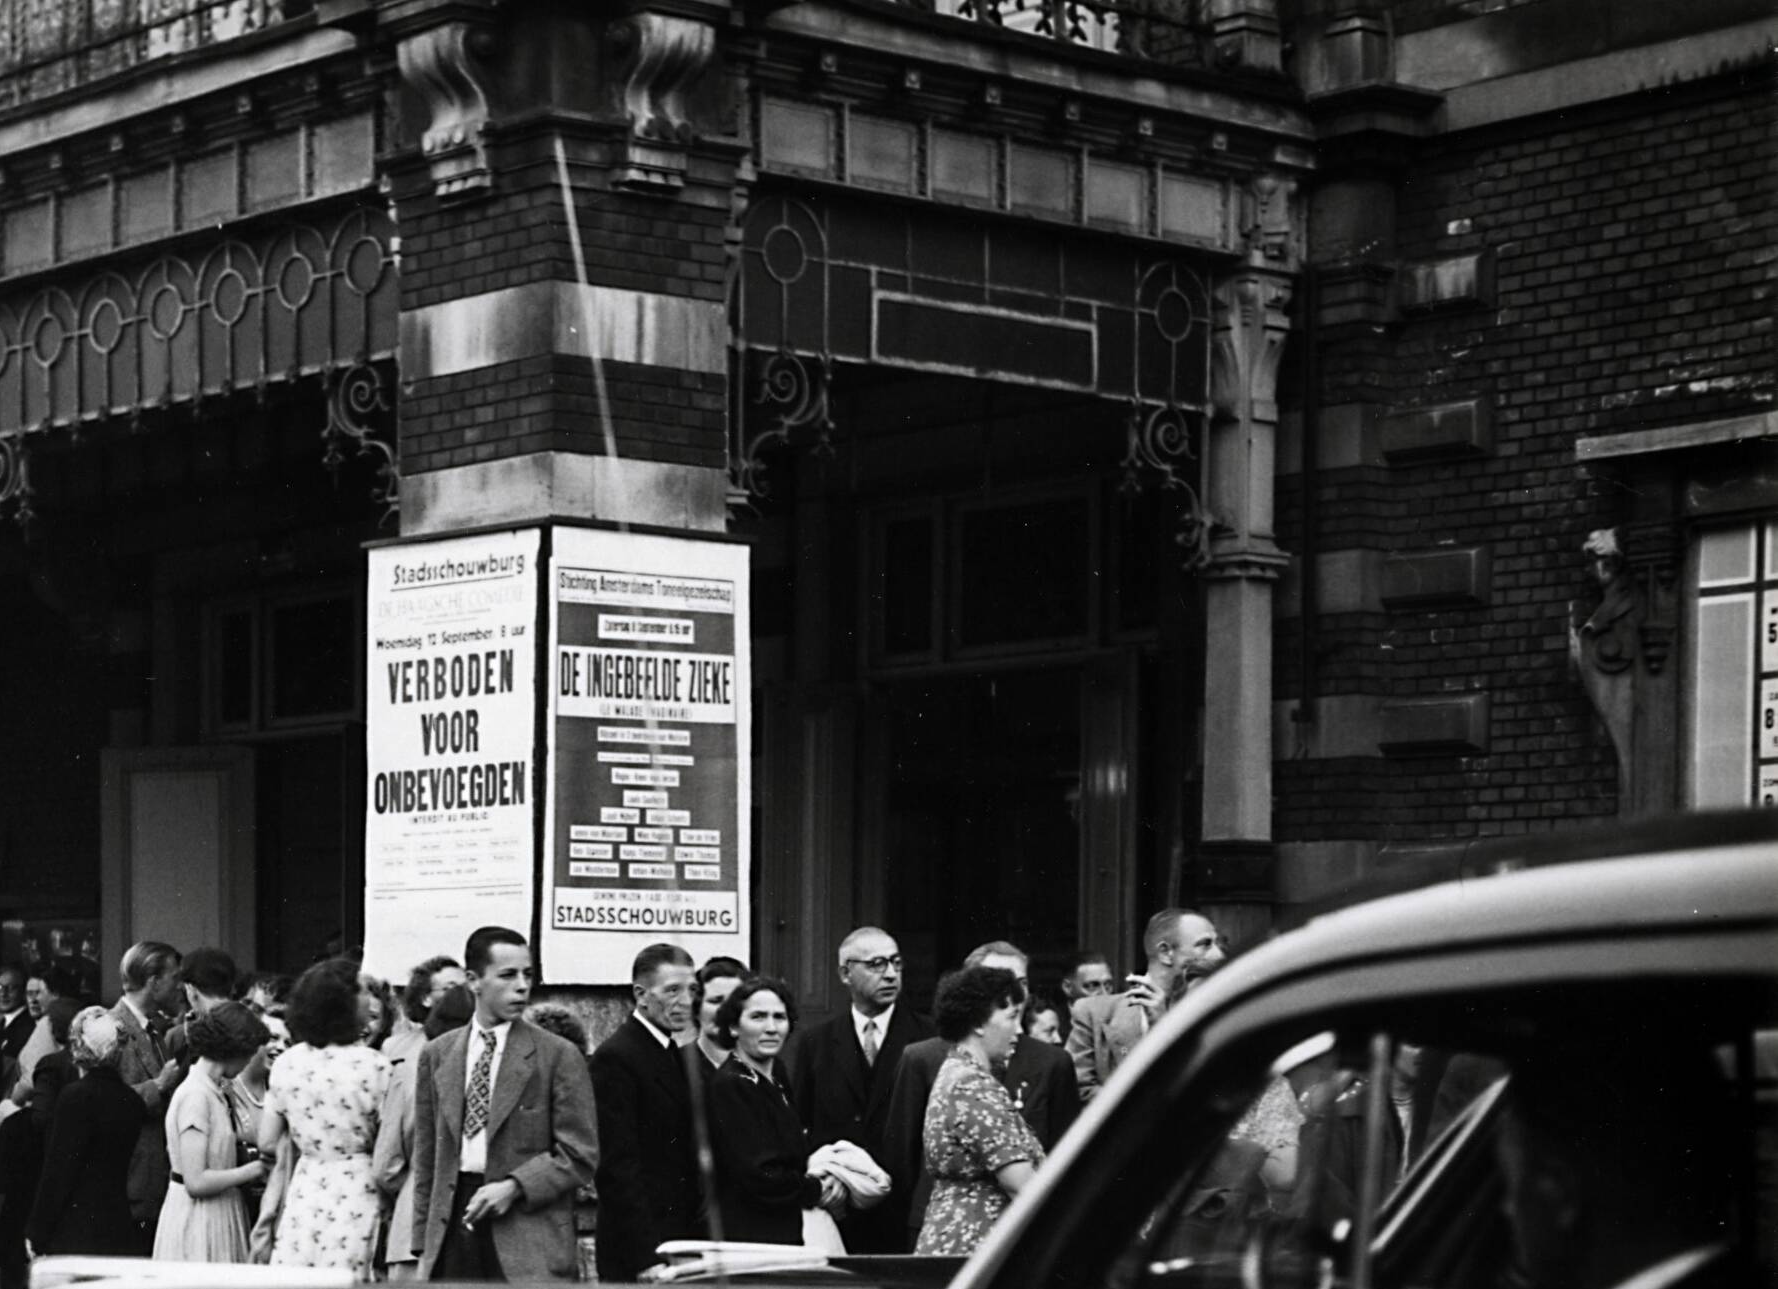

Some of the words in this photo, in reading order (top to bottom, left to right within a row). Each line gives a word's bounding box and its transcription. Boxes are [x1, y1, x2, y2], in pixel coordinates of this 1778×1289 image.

[393, 553, 525, 585] Stadsschouwburg
[560, 572, 598, 594] Stichting
[441, 626, 495, 645] September
[510, 625, 526, 637] uur
[387, 649, 514, 705] VERBODEN
[560, 651, 580, 697] DE
[587, 654, 681, 701] INGEBEELDE
[688, 660, 731, 704] ZIEKE
[421, 709, 479, 756] VOOR
[374, 760, 526, 815] ONBEVOEGDEN
[556, 905, 733, 927] STADSSCHOUWBURG
